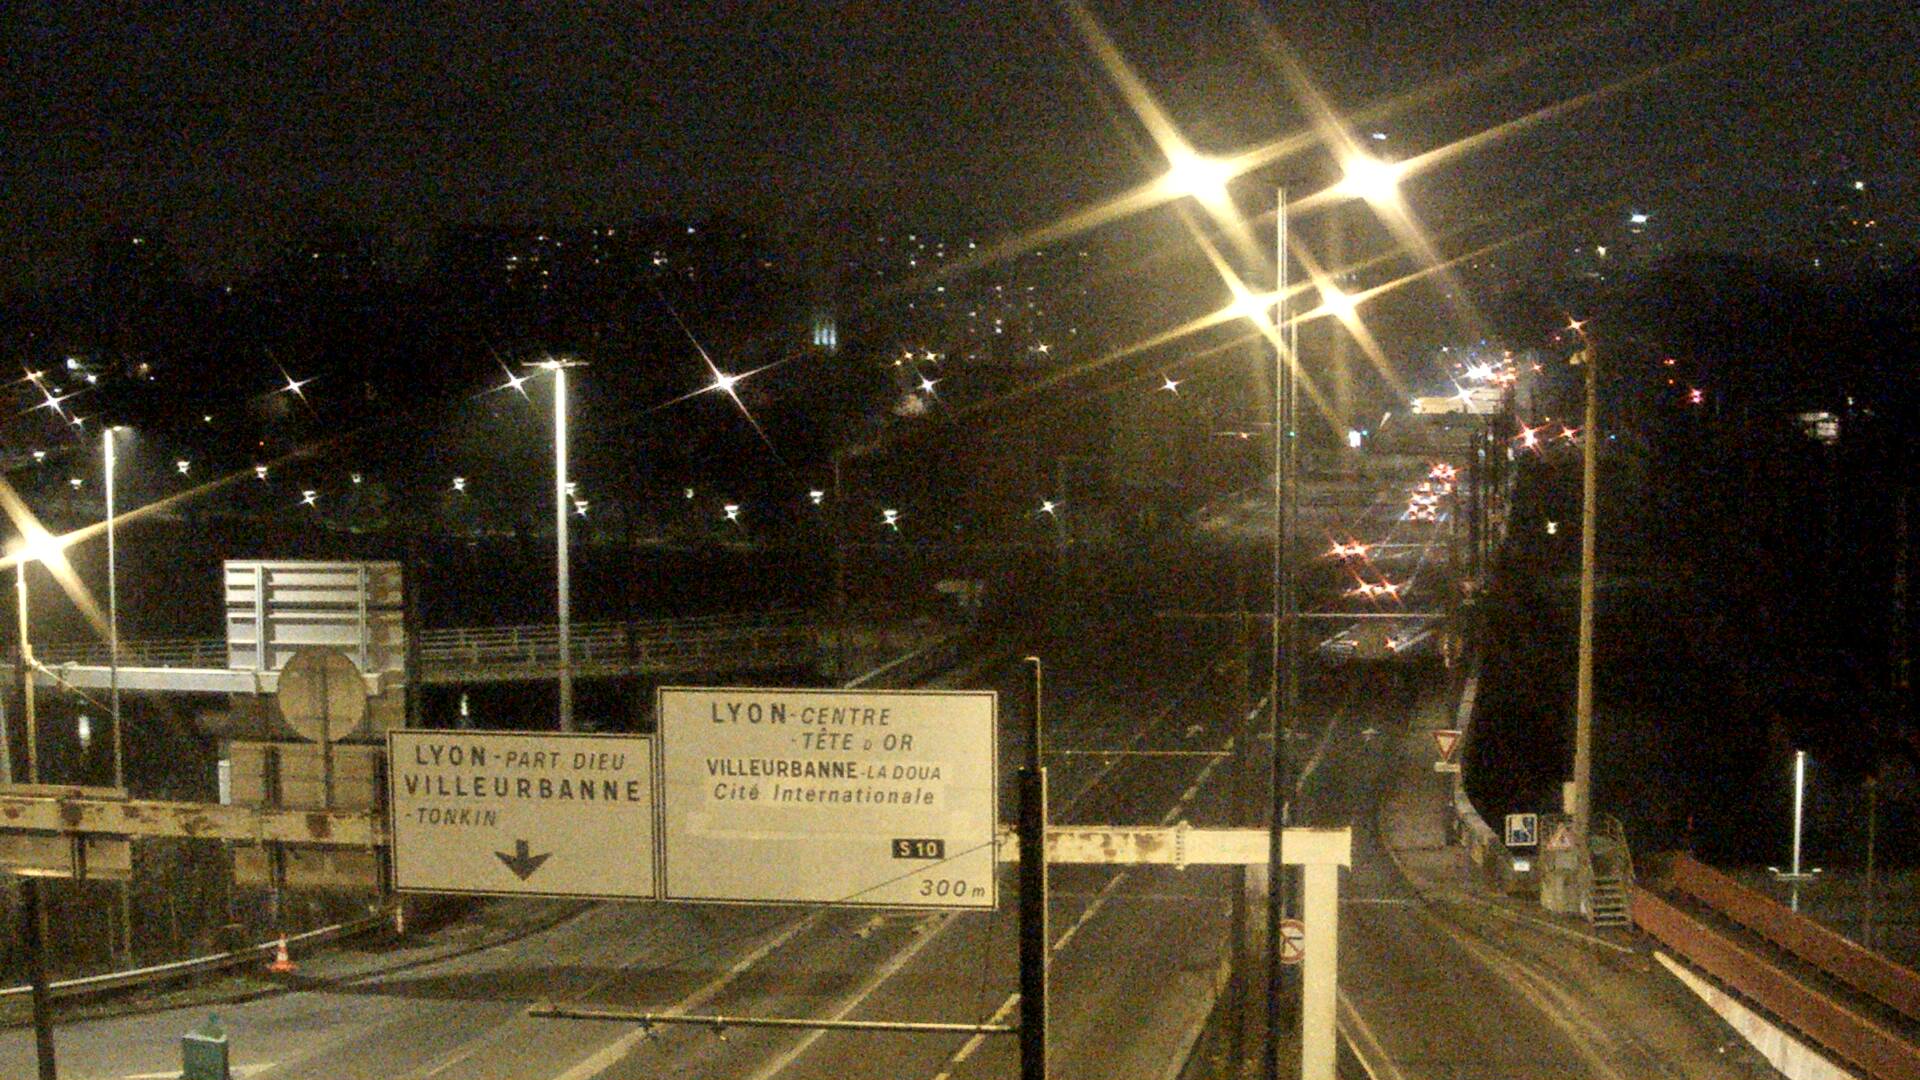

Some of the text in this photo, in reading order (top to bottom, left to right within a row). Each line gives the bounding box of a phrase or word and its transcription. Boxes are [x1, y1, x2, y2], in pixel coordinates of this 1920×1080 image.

[883, 734, 914, 752] OR
[573, 752, 626, 771] DIEU
[892, 765, 942, 780] DOUA
[404, 774, 641, 801] VILLEURBANNE
[714, 782, 934, 805] Cité Internationale
[919, 879, 967, 897] 300
